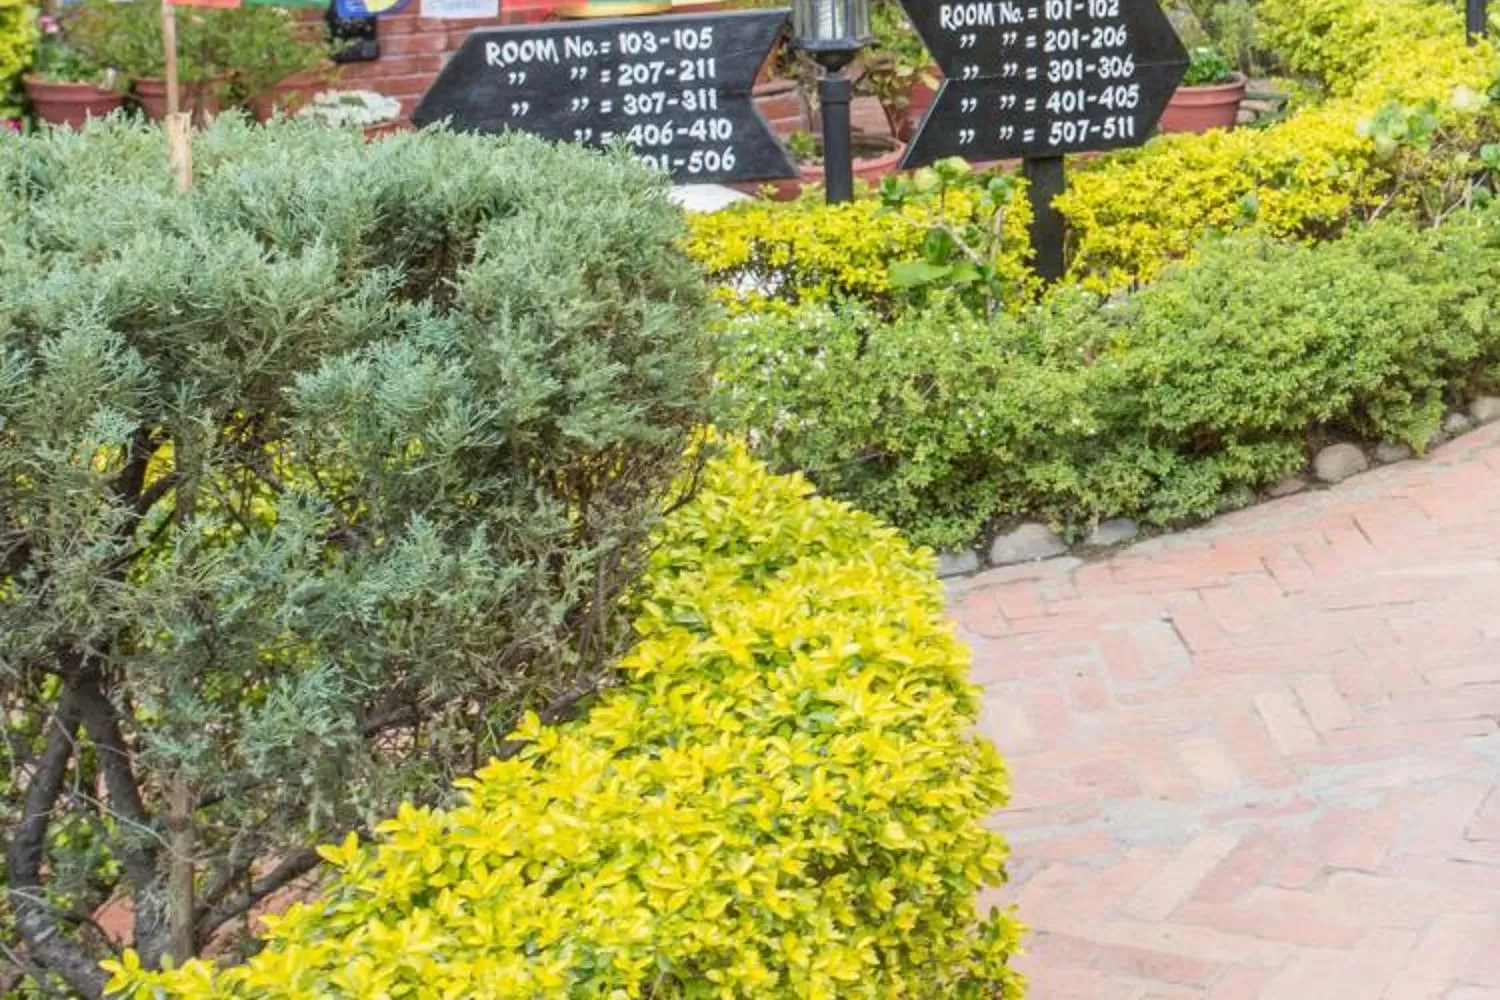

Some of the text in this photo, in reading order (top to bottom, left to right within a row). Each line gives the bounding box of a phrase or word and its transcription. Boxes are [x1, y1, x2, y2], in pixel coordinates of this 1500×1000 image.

[939, 2, 995, 31] ROOM
[485, 38, 559, 67] ROOM
[618, 27, 714, 54] 103-105
[1043, 24, 1127, 52] 201-206
[617, 58, 717, 86] 207-211
[1048, 54, 1135, 83] 301-306
[623, 88, 717, 116] 307-311
[1045, 83, 1140, 113] 401-405
[626, 118, 733, 146] 406-410
[1048, 116, 1135, 146] 507-511
[636, 146, 736, 174] 01-506
